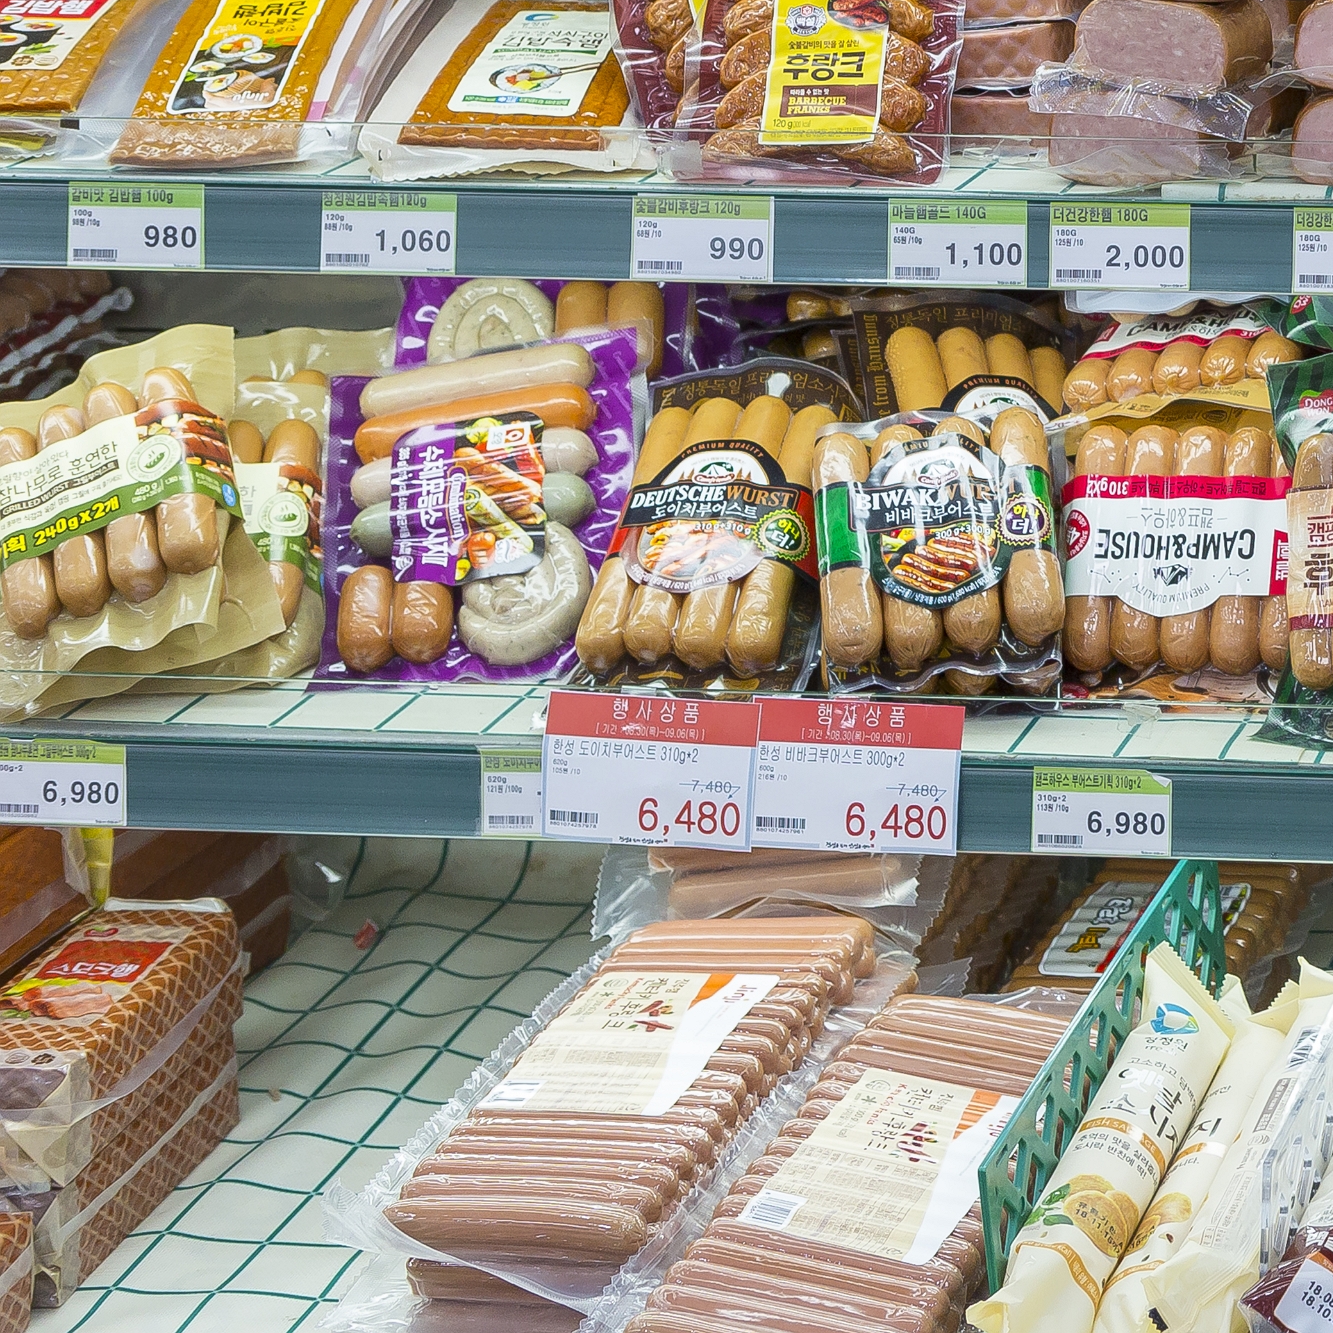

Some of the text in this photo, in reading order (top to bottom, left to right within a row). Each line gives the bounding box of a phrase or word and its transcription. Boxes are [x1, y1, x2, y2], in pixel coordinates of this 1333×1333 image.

[781, 50, 866, 81] 후랑크
[788, 94, 847, 107] BARBECUE
[893, 206, 985, 219] 마늘햄골드 140G
[1053, 207, 1147, 224] 더건강한햄 180G
[145, 226, 196, 247] 980
[376, 230, 450, 254] 1,060
[710, 238, 763, 260] 990
[946, 243, 1021, 268] 1,100
[1106, 245, 1183, 270] 2,000
[652, 500, 760, 522] 도이치부어스트
[1091, 526, 1257, 561] CAMP&HOUSE
[554, 739, 656, 759] 한성 도이치부어스트
[760, 745, 862, 764] 한성 비바크부어스트
[43, 781, 118, 806] 6,980
[691, 780, 732, 793] 7,480
[899, 784, 938, 797] 7,480
[639, 795, 740, 836] 6,480
[846, 802, 946, 840] 6,480
[1088, 811, 1165, 836] 6,980
